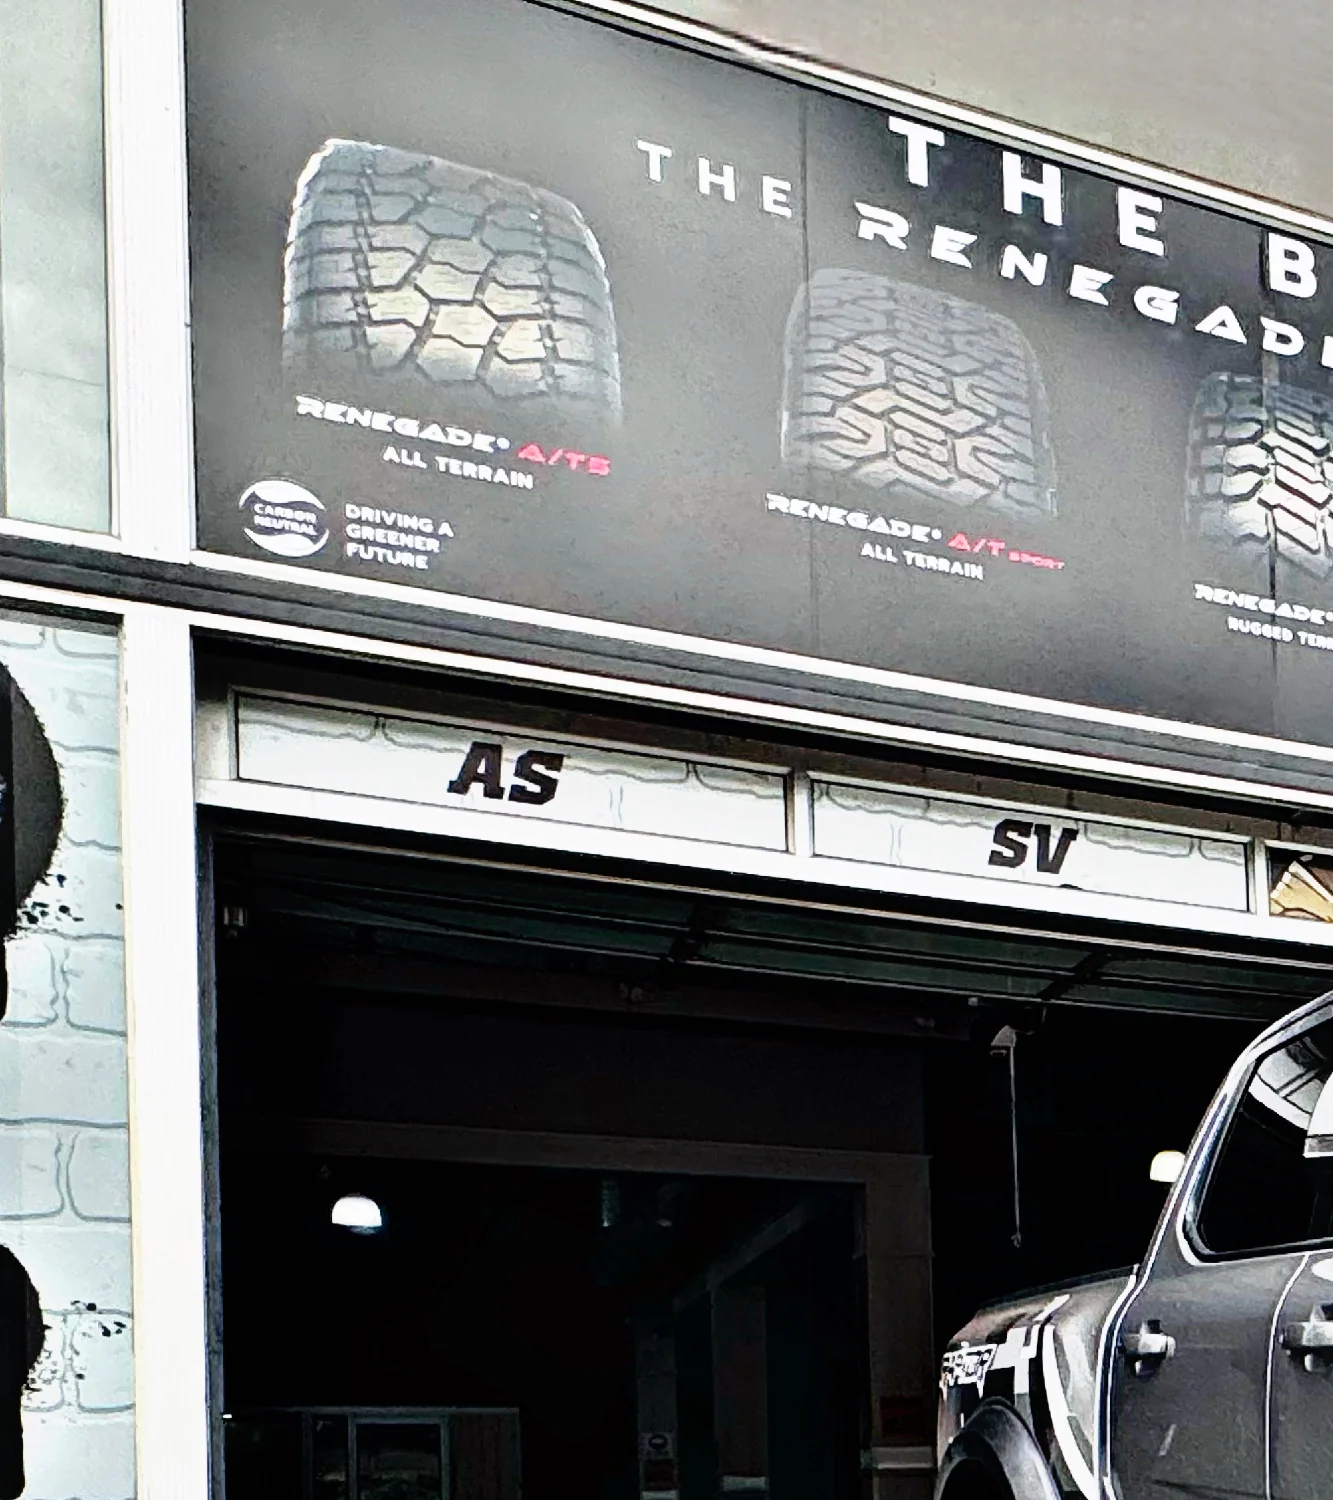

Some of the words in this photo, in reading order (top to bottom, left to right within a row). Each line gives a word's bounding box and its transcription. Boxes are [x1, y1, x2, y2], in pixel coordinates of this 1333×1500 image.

[636, 138, 793, 218] THE
[887, 115, 1167, 257] THE
[295, 395, 495, 454] RENEGADE
[382, 445, 428, 470] ALL
[434, 455, 535, 490] TERRAIN
[345, 503, 435, 534] DRIVING
[437, 519, 455, 538] A
[345, 524, 441, 553] GREENER
[346, 542, 429, 570] FUTURE
[860, 542, 898, 564] ALL
[903, 550, 985, 581] TERRAIN
[947, 531, 1006, 556] A/T
[1227, 616, 1294, 643] RUGGED
[447, 741, 564, 806] AS
[986, 819, 1079, 876] SV
